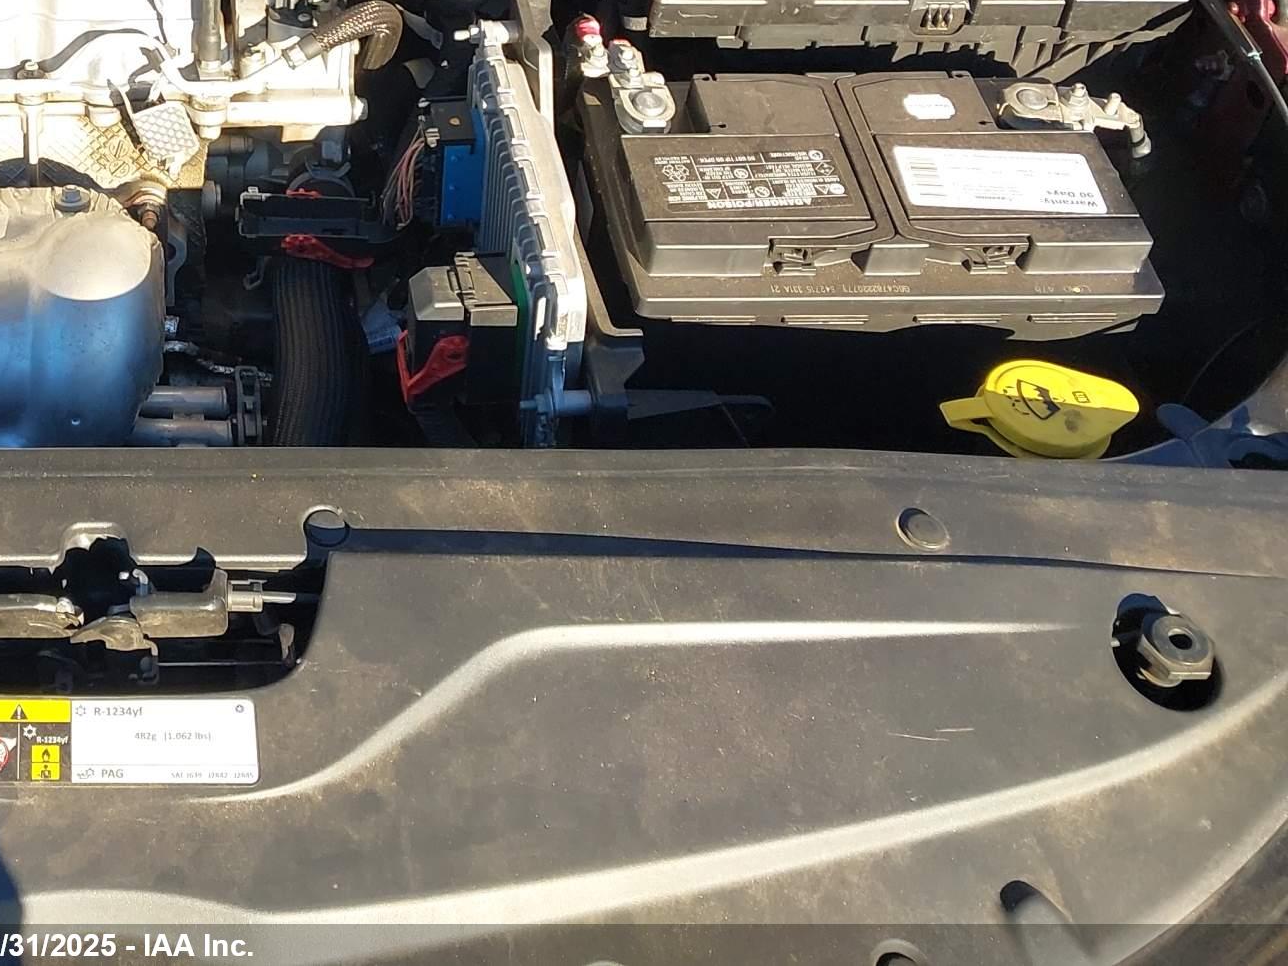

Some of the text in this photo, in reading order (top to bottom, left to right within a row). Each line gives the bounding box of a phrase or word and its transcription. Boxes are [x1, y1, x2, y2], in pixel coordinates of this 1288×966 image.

[93, 706, 143, 717] R-1234yf
[36, 735, 69, 745] R-1234yf
[101, 769, 124, 779] PAG
